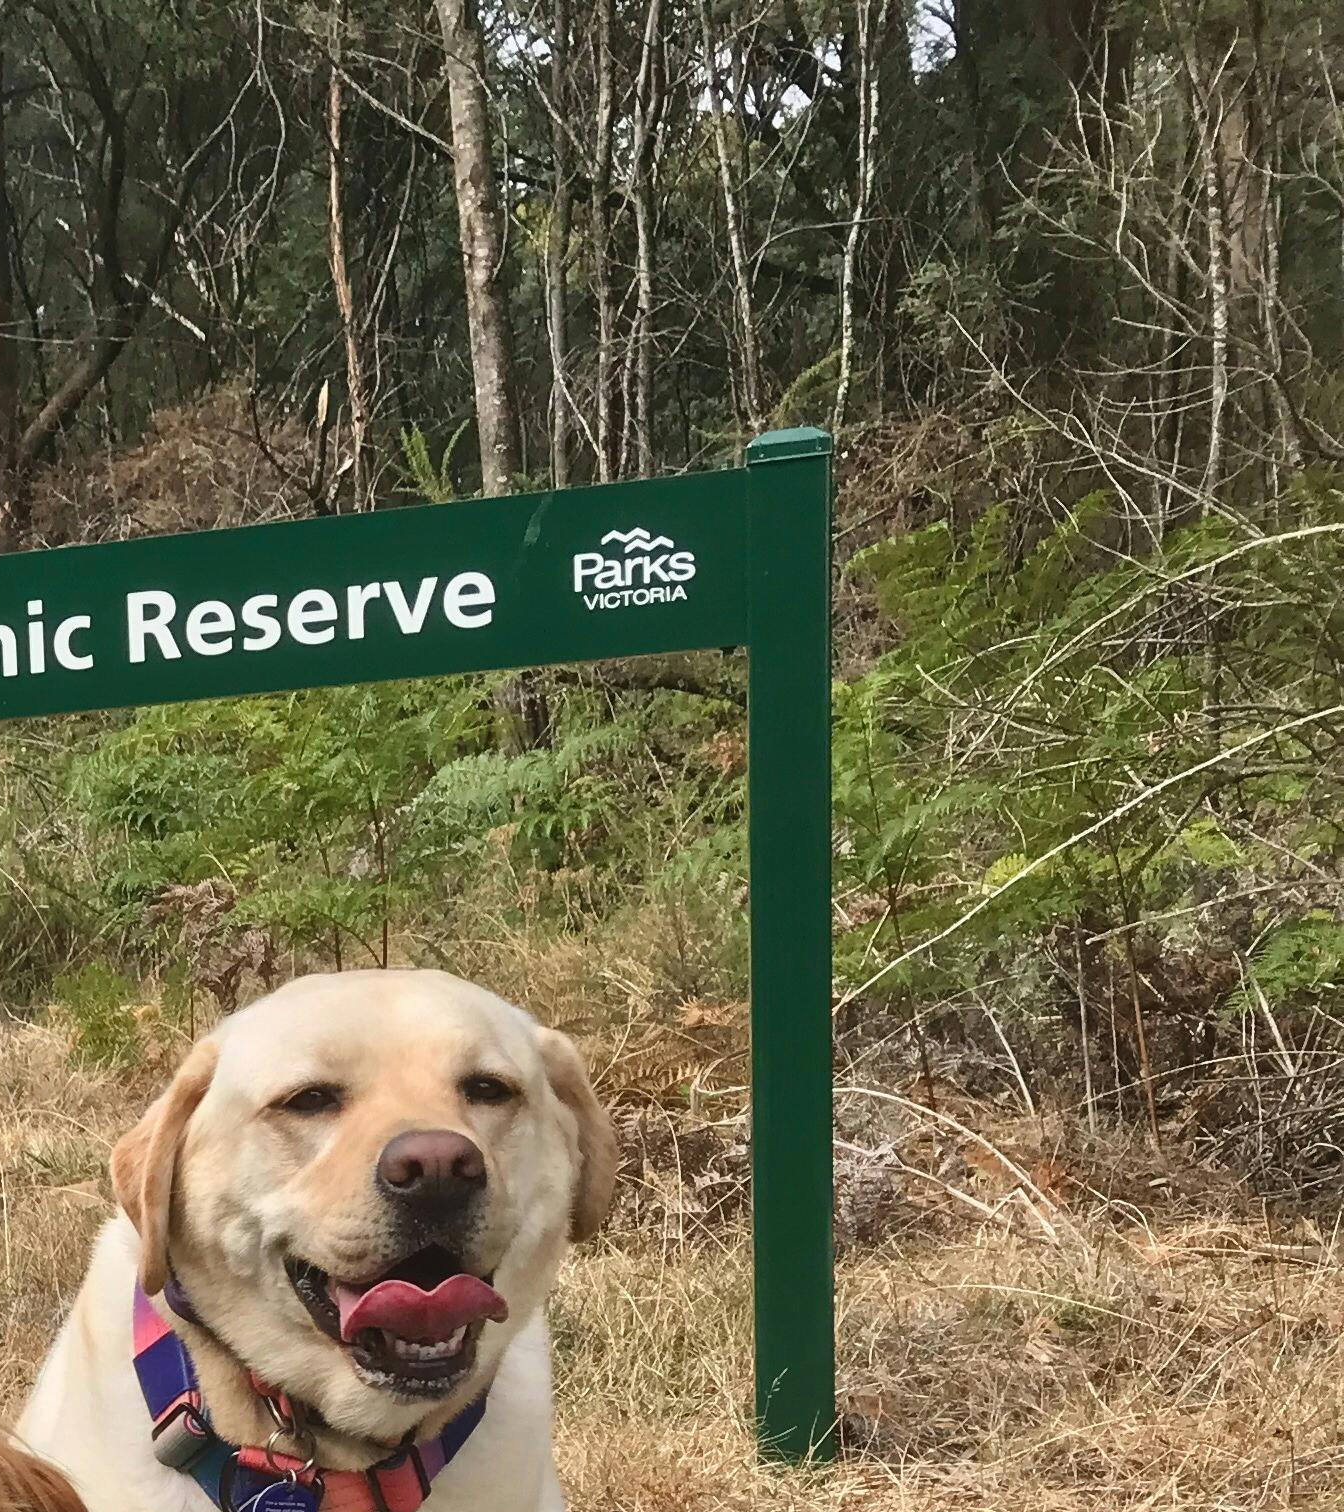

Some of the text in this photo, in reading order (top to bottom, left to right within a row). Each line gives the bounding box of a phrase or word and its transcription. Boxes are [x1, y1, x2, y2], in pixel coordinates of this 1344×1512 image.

[573, 551, 697, 593] Parks
[126, 571, 496, 663] Reserve
[583, 584, 688, 611] VICTORIA
